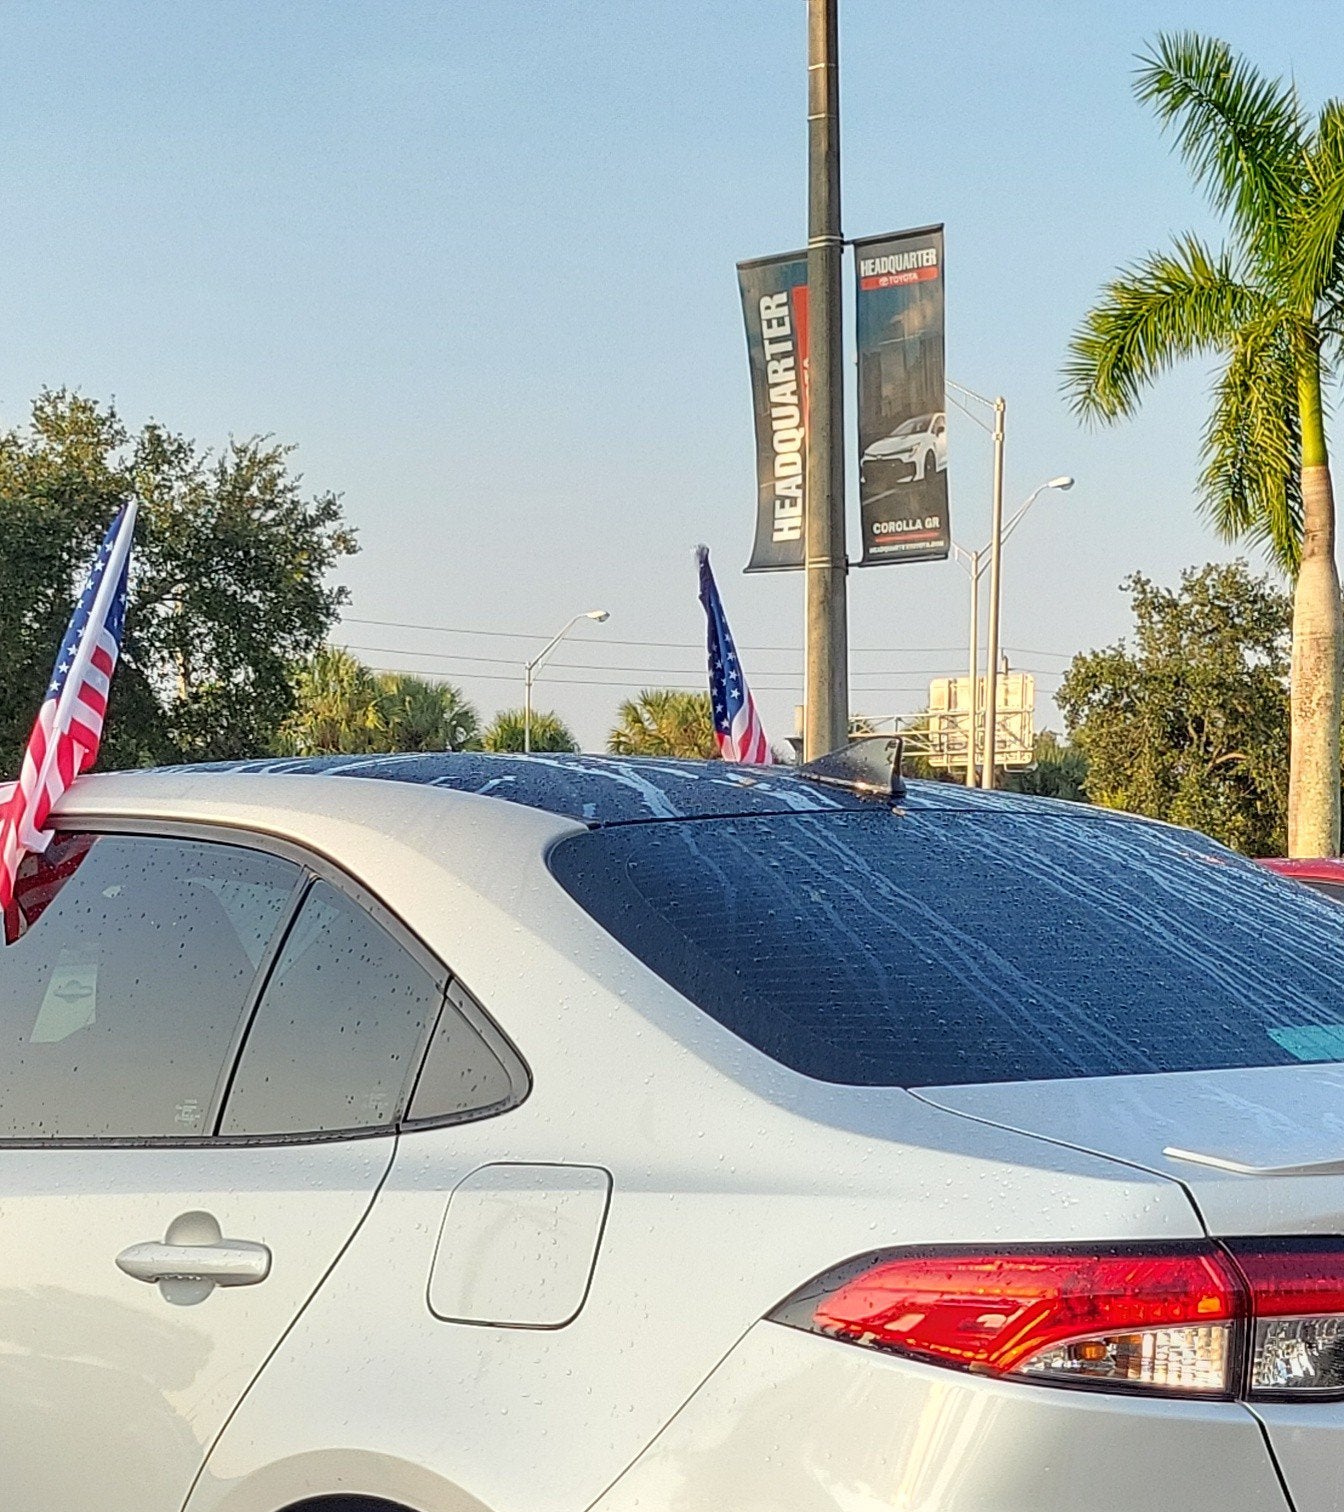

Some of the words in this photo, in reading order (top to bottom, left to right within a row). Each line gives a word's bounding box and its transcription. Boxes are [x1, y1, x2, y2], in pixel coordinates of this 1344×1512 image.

[860, 248, 937, 274] HEADQUARTER
[889, 272, 919, 285] TOYOTA
[760, 291, 805, 542] HEADQUARTER
[872, 519, 923, 534] COROLLA
[924, 516, 940, 529] GR
